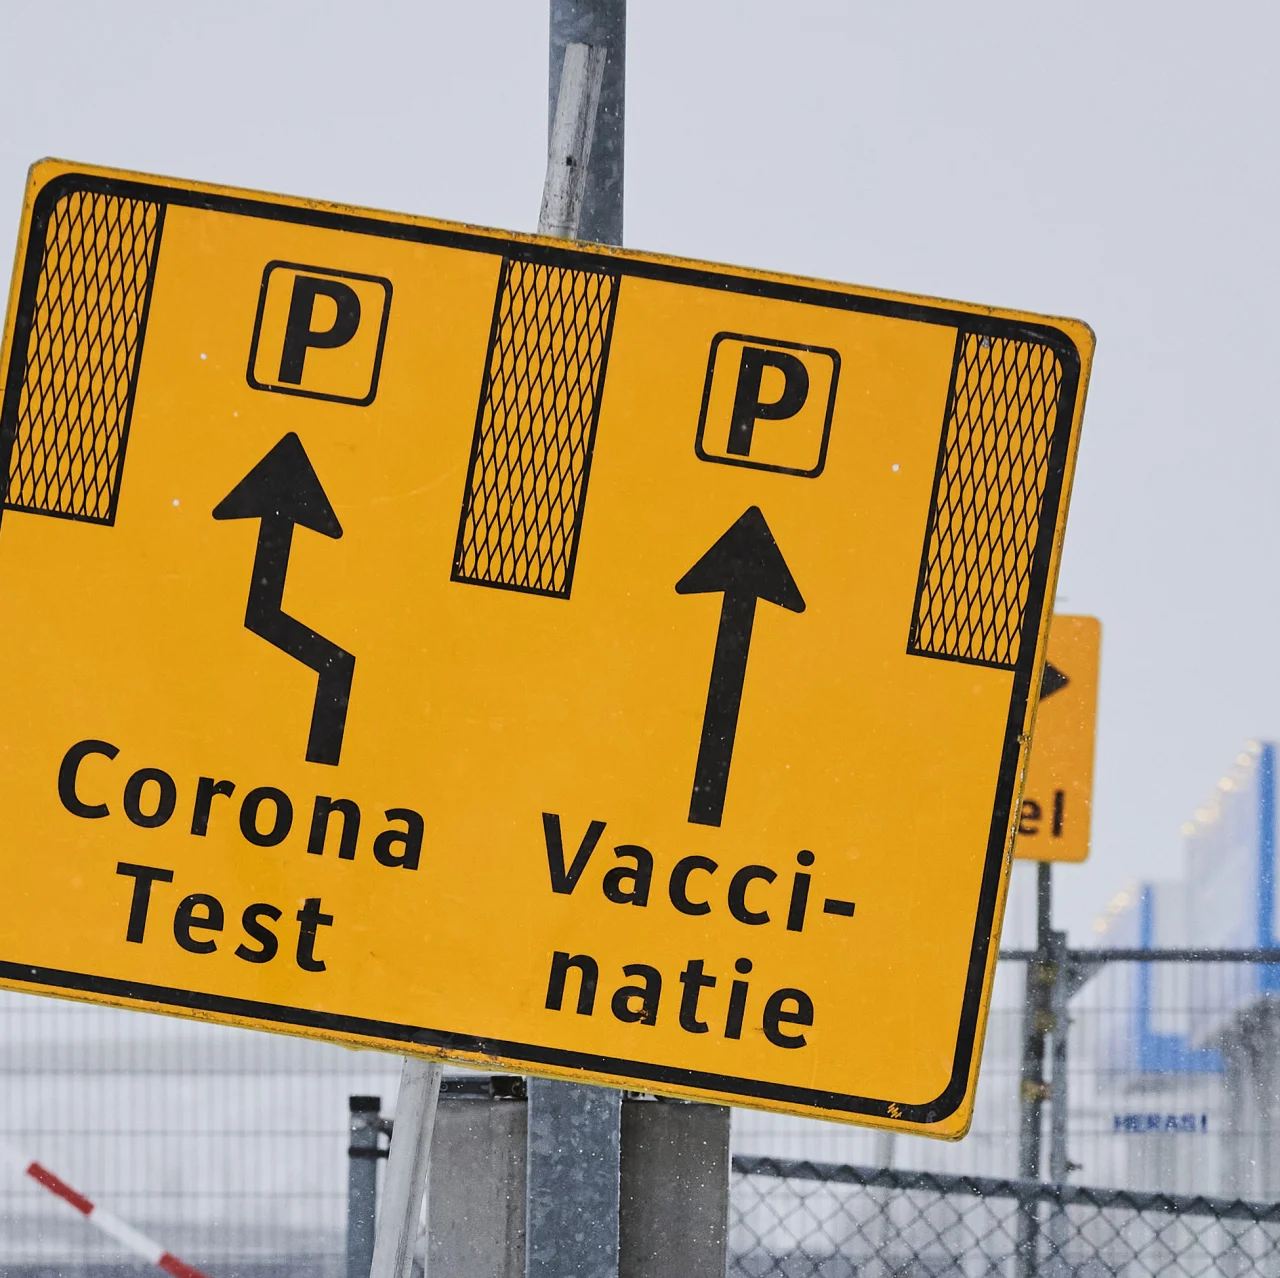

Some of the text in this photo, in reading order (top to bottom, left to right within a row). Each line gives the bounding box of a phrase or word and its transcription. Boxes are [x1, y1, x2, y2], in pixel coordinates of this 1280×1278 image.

[278, 274, 362, 385] P
[726, 346, 810, 457] P
[57, 739, 427, 872] Corona
[117, 862, 335, 973] Test
[541, 813, 856, 933] Vacci-
[545, 947, 815, 1050] natie
